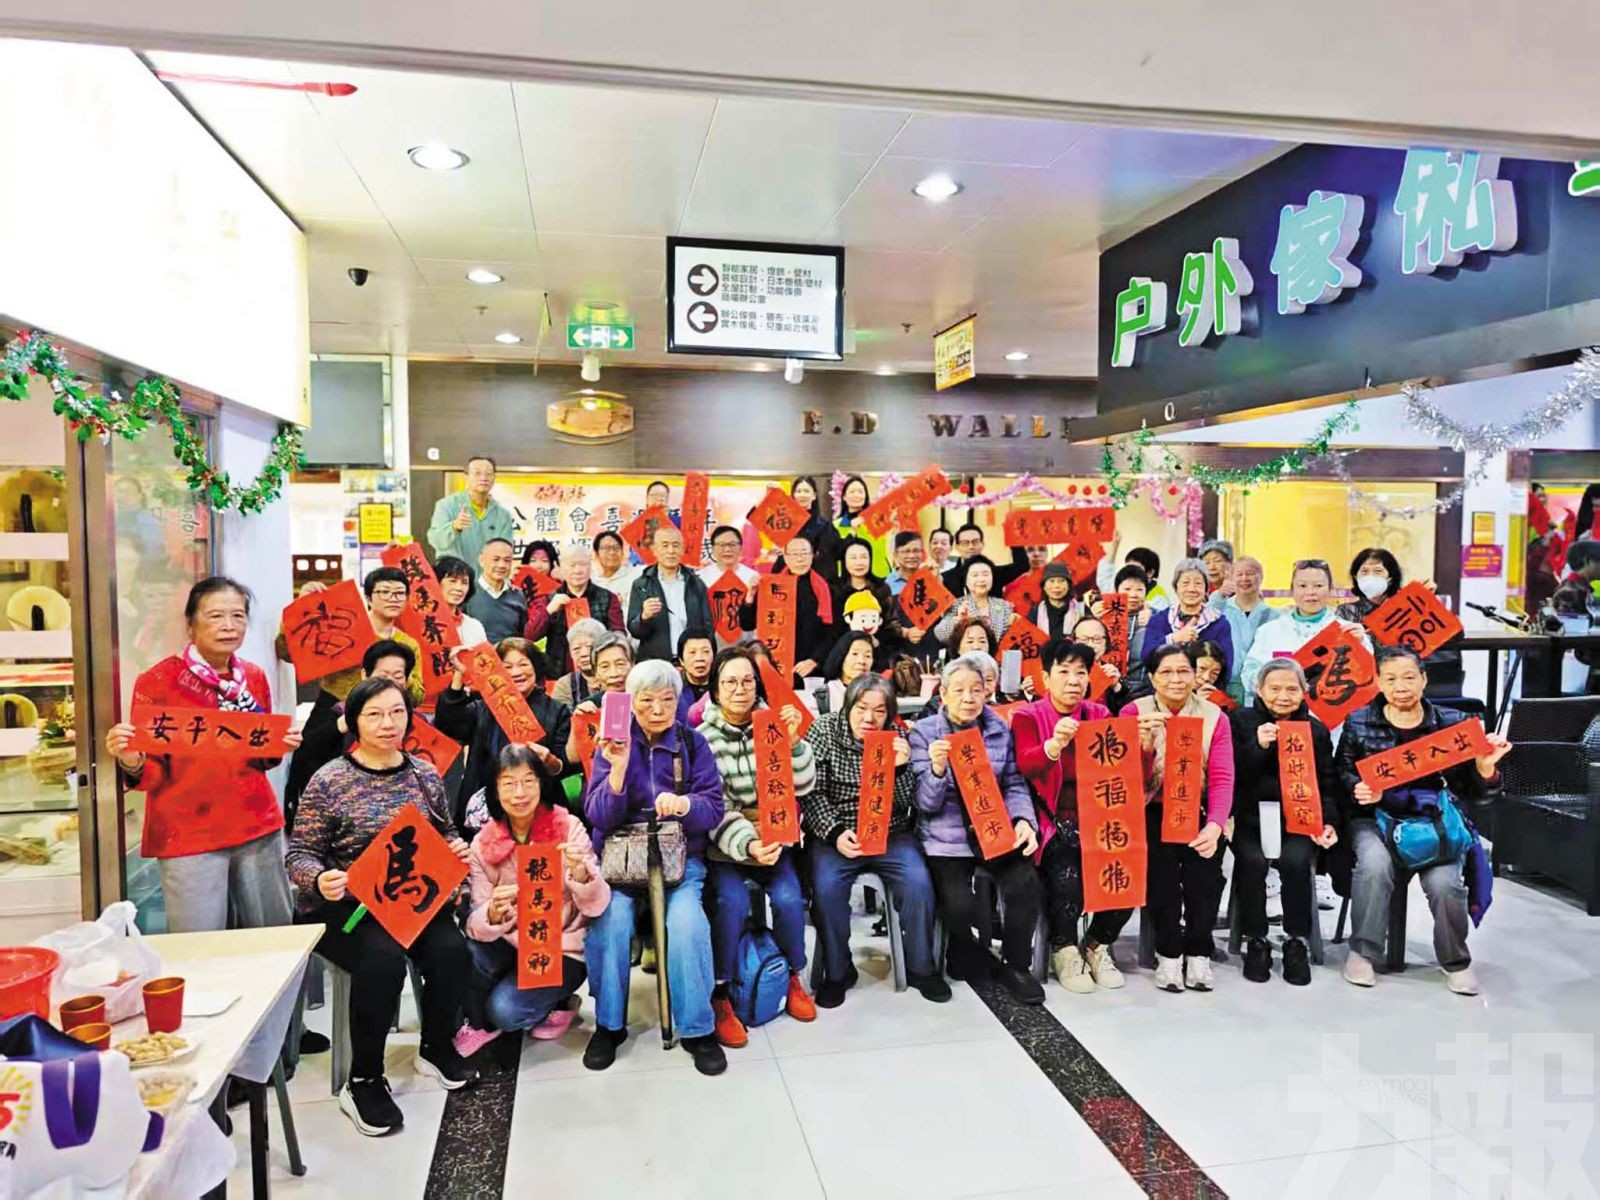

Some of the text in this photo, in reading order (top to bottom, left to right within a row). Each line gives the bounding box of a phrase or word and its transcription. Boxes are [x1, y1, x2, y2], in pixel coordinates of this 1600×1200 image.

[765, 503, 794, 531] 福
[374, 825, 440, 914] 馬
[524, 856, 554, 977] 龍馬精神
